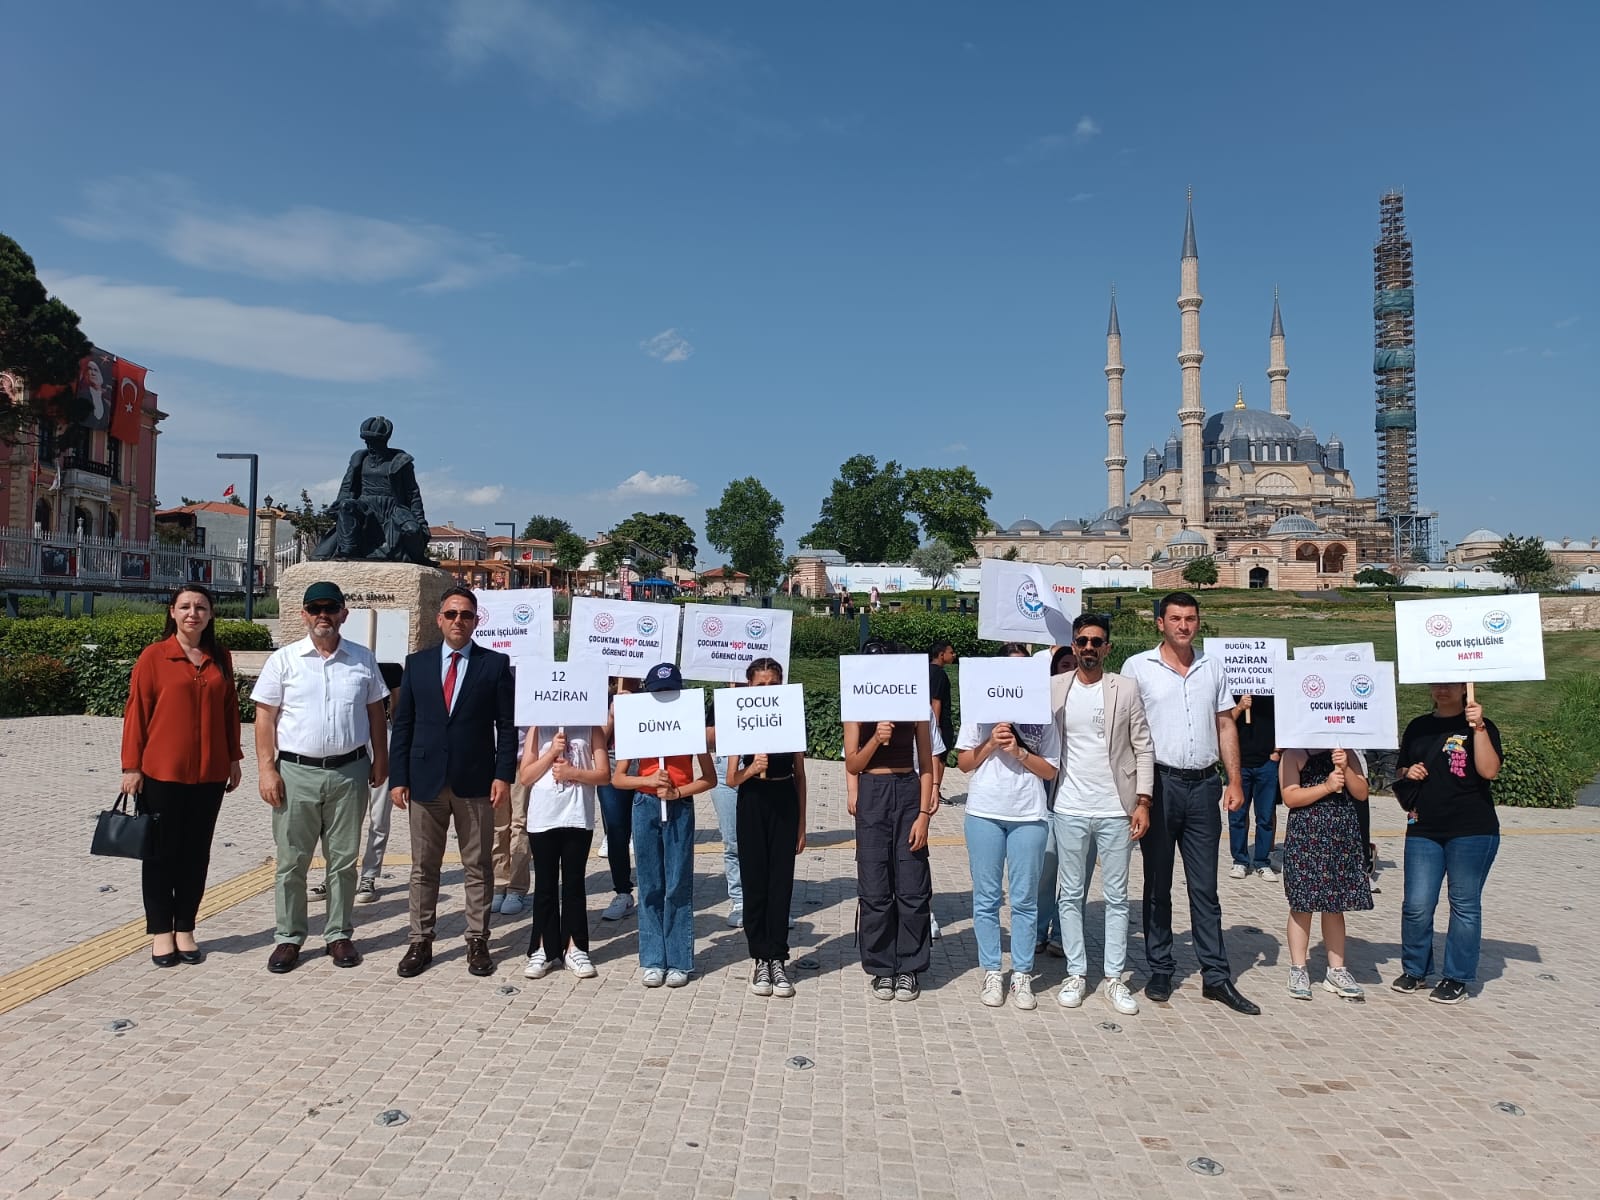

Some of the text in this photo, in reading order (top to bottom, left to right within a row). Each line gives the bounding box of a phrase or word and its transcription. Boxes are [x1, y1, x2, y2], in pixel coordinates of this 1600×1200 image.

[343, 593, 364, 602] OCA
[475, 627, 528, 638] ÇOCUK İŞÇİLİĞİNE
[588, 635, 620, 644] ÇOCUKTAN
[638, 639, 660, 648] OLMAZ!
[697, 639, 729, 648] ÇOCUKTAN
[747, 642, 769, 651] OLMAZ!
[1254, 641, 1266, 650] 12
[1435, 635, 1504, 650] ÇOCUK İŞÇİLİĞİNE
[601, 647, 644, 658] ÖĞRENCİ OLUR
[711, 651, 737, 660] ÖĞRENCİ
[1457, 651, 1484, 660] HAYIR!
[1224, 654, 1268, 664] HAZİRAN
[1224, 665, 1273, 675] ÜNYA ÇOCUK
[551, 671, 566, 682] 12
[1255, 676, 1266, 684] İLE
[853, 682, 918, 695] MÜCADELE
[987, 685, 1024, 699] GÜNÜ
[534, 688, 588, 702] HAZİRAN
[736, 696, 780, 711] ÇOCUK
[1310, 700, 1368, 712] ÇOCUK İŞÇİLİĞİNE
[736, 713, 782, 731] İŞÇİLİĞİ
[1346, 716, 1356, 724] DE
[638, 719, 681, 733] DÜNYA
